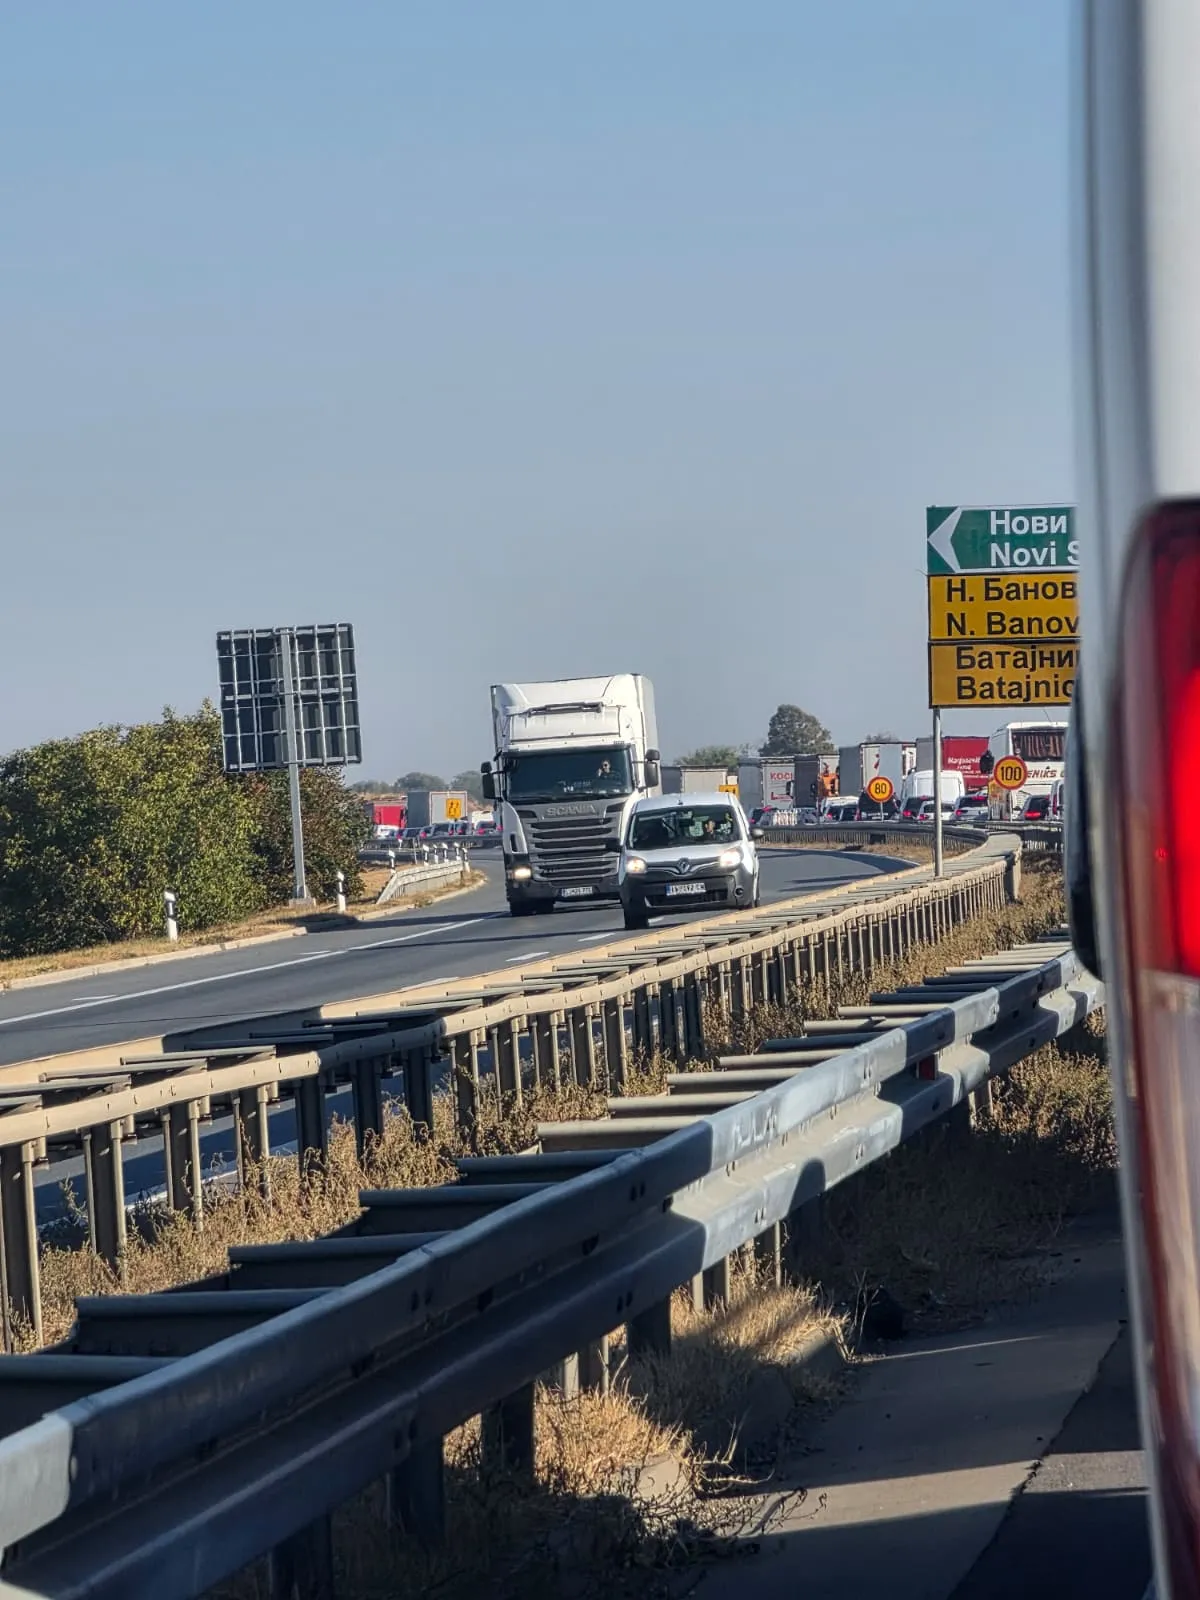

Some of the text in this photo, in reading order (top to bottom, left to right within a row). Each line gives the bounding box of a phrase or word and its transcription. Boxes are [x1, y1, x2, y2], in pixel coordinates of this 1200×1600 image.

[990, 510, 1067, 536] Нови
[990, 540, 1080, 567] Novi S
[946, 577, 1078, 603] Н. Банов
[946, 611, 1080, 636] N. Banov
[956, 645, 1079, 671] Батајни
[957, 673, 1074, 702] Batajnic
[1001, 766, 1022, 781] 100
[1027, 769, 1057, 778] ENIKS
[874, 782, 887, 795] 80
[546, 804, 597, 816] SCANIA
